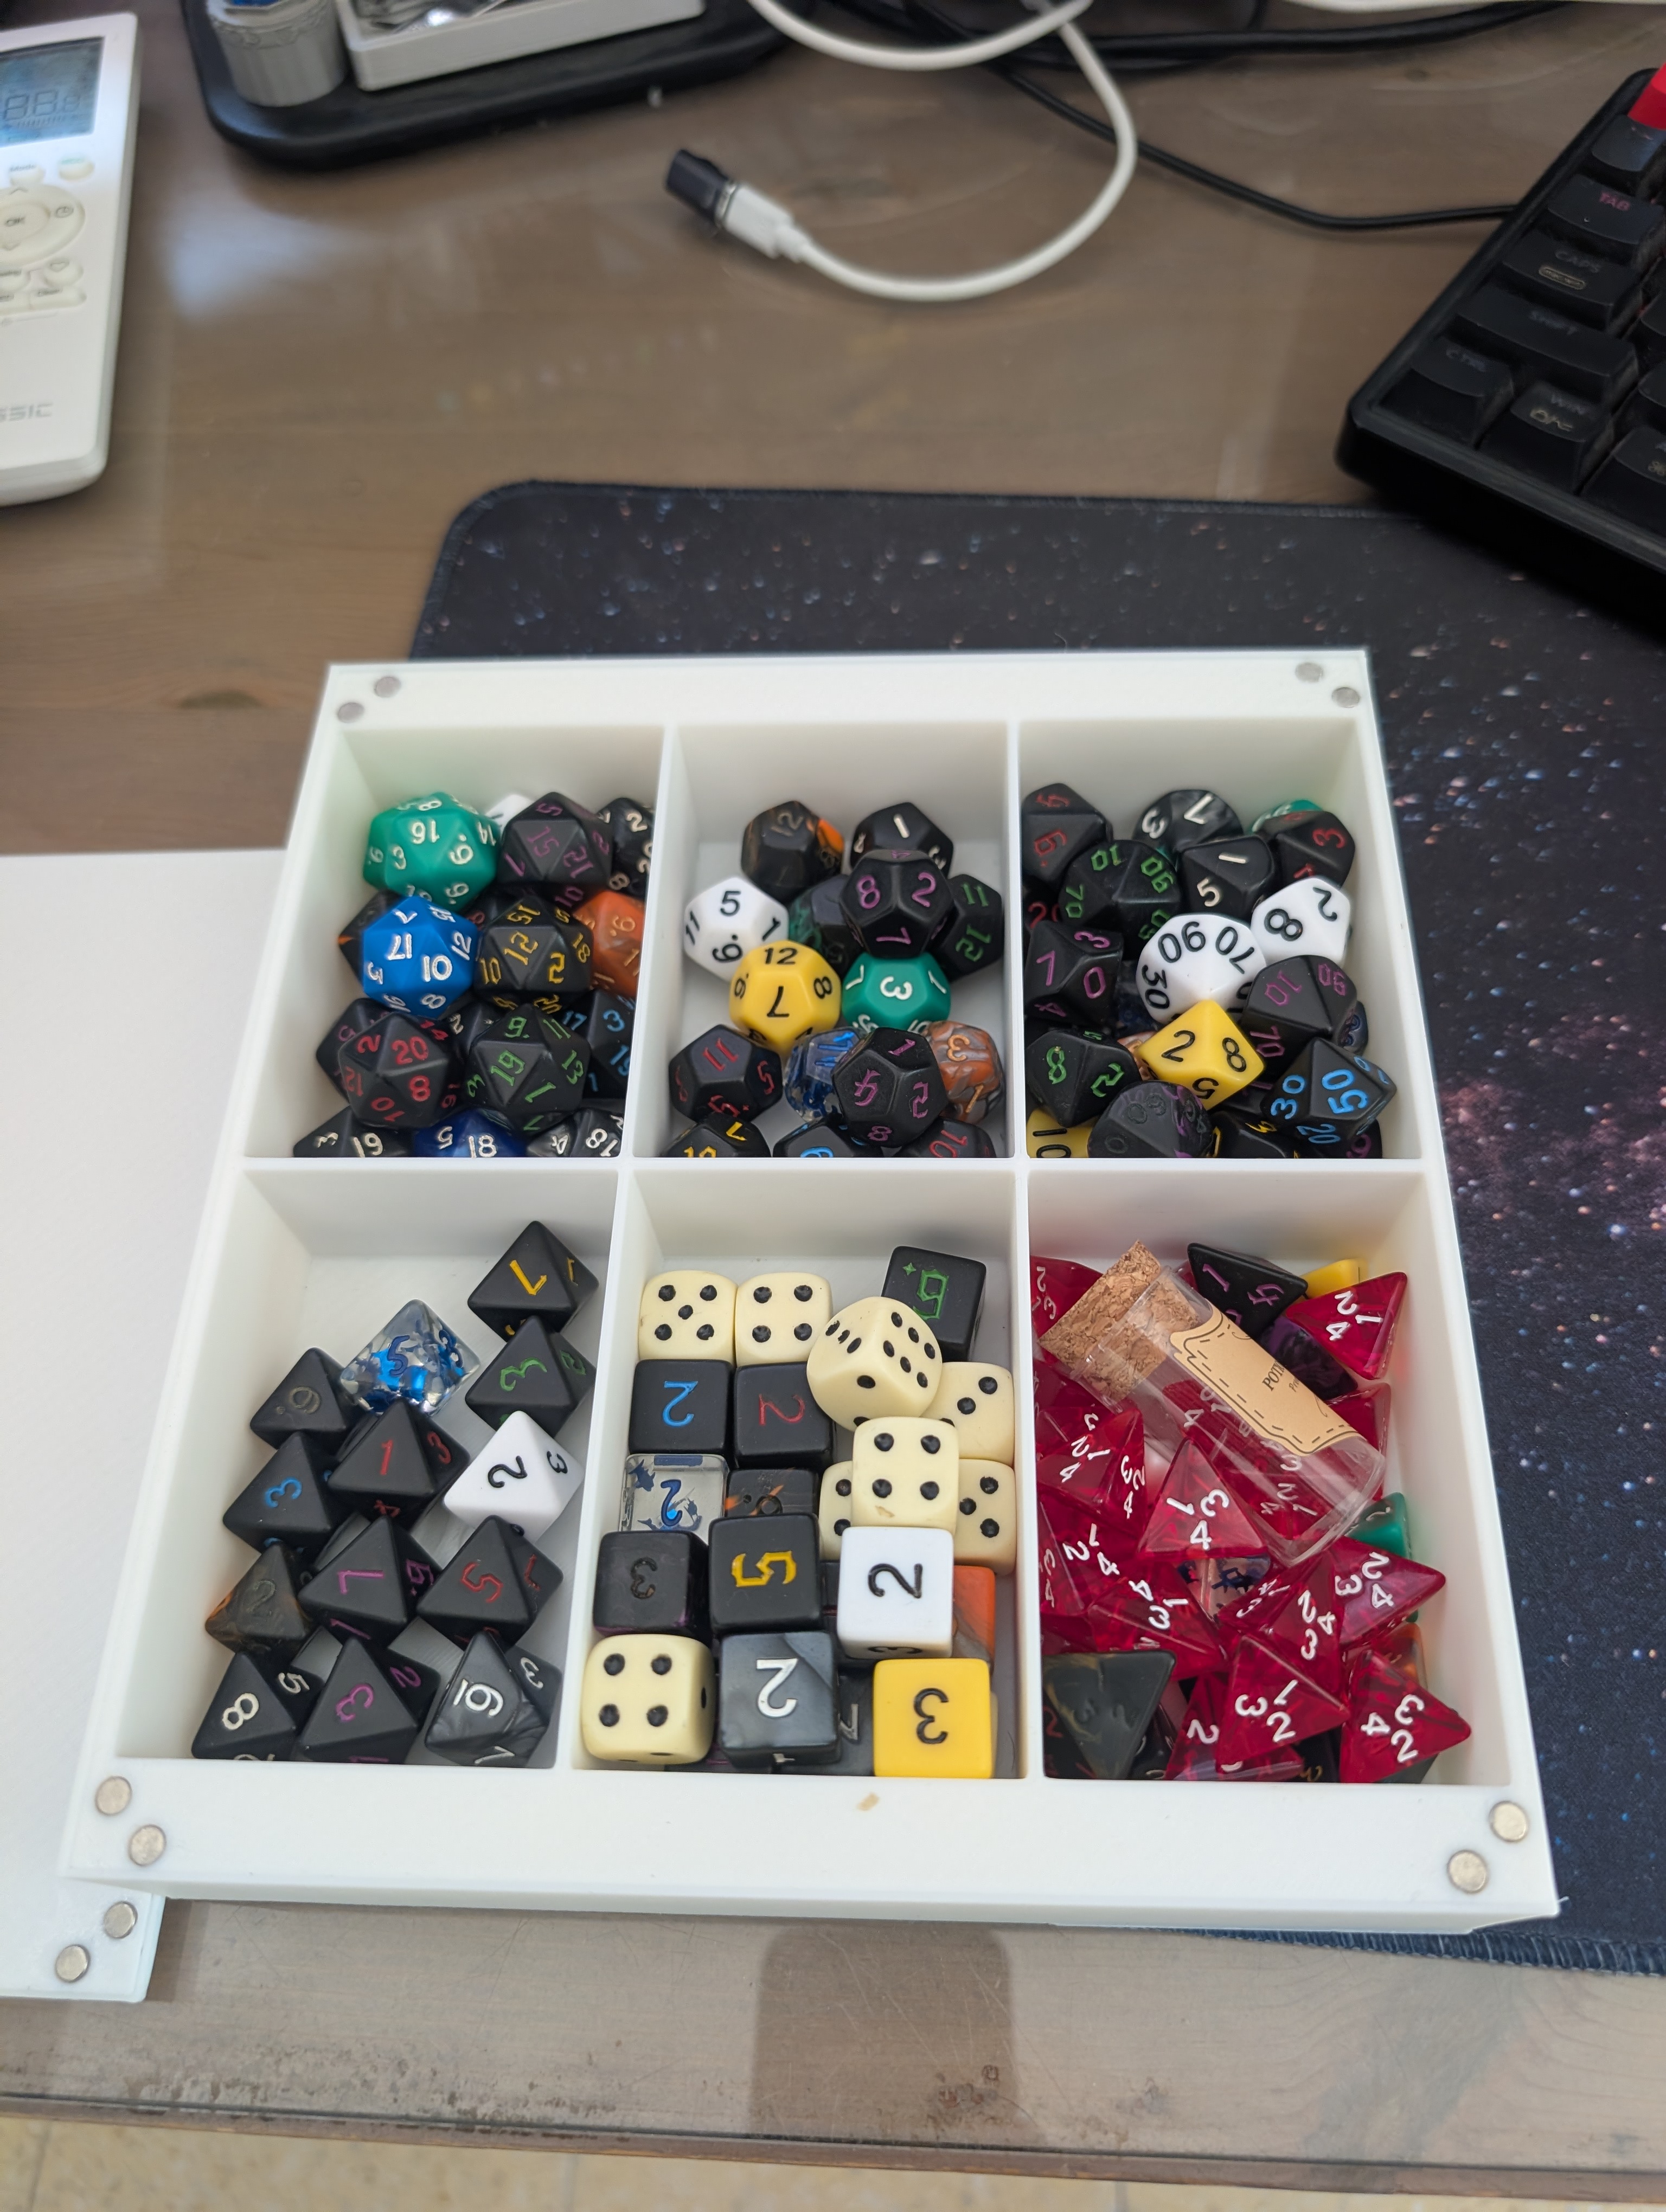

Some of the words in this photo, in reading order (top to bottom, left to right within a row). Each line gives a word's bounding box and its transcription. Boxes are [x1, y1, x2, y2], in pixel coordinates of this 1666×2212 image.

[1142, 809, 1167, 839] 3
[1184, 795, 1213, 825] 7
[893, 814, 911, 839] 1
[1312, 828, 1345, 849] 3
[720, 891, 741, 917] 5
[856, 874, 881, 909] 8
[912, 871, 937, 908] 2
[962, 882, 989, 907] 11
[1196, 876, 1221, 907] 5
[1312, 886, 1337, 922] 2
[685, 911, 700, 946] 11
[1074, 930, 1111, 949] 3
[1264, 908, 1303, 941] 8
[504, 930, 539, 965] 12
[572, 933, 591, 963] 18
[765, 948, 798, 965] 12
[422, 955, 453, 982] 10
[479, 957, 502, 985] 10
[548, 951, 565, 984] 2
[813, 976, 832, 999] 8
[880, 975, 913, 1000] 3
[1083, 967, 1106, 999] 0
[1141, 964, 1170, 1009] 30
[1265, 971, 1302, 1006] 10
[420, 993, 446, 1009] 8
[767, 986, 790, 1017] 7
[603, 1008, 625, 1032] 3
[356, 1034, 381, 1053] 2
[392, 1036, 429, 1065] 20
[702, 1038, 738, 1072] 11
[947, 1034, 970, 1062] 3
[1161, 1030, 1195, 1063] 2
[1222, 1037, 1247, 1072] 8
[491, 1050, 525, 1086] 19
[561, 1050, 584, 1084] 13
[1046, 1046, 1067, 1085] 8
[1090, 1062, 1125, 1098] 2
[409, 1075, 431, 1102] 8
[1271, 1075, 1306, 1120] 30
[1322, 1069, 1368, 1114] 50
[467, 1135, 497, 1158] 18
[868, 1126, 892, 1141] 8
[1202, 1263, 1229, 1293] 1
[1335, 1290, 1359, 1316] 2
[1326, 1321, 1351, 1341] 4
[1355, 1314, 1384, 1326] 1
[499, 1356, 548, 1391] 3
[662, 1380, 699, 1427] 2
[759, 1393, 805, 1426] 2
[381, 1439, 393, 1475] 1
[1071, 1435, 1091, 1457] 2
[1087, 1449, 1111, 1460] 1
[488, 1455, 528, 1488] 2
[547, 1450, 568, 1474] 3
[1060, 1462, 1081, 1483] 4
[1121, 1455, 1133, 1484] 3
[265, 1476, 303, 1508] 3
[660, 1479, 683, 1527] 2
[1167, 1497, 1195, 1515] 1
[1200, 1489, 1229, 1517] 3
[1277, 1483, 1299, 1501] 2
[1089, 1523, 1100, 1547] 1
[1190, 1520, 1212, 1550] 4
[1062, 1541, 1090, 1561] 2
[1097, 1551, 1120, 1576] 4
[1361, 1552, 1389, 1579] 2
[461, 1561, 503, 1603] 5
[630, 1557, 658, 1599] 3
[731, 1550, 797, 1588] 5
[868, 1563, 923, 1599] 2
[1128, 1580, 1154, 1602] 4
[1334, 1574, 1363, 1596] 3
[1372, 1583, 1394, 1609] 4
[1148, 1605, 1171, 1630] 3
[1162, 1598, 1189, 1608] 1
[1298, 1590, 1317, 1623] 2
[1317, 1611, 1336, 1635] 4
[1300, 1629, 1318, 1661] 3
[278, 1672, 311, 1694] 5
[520, 1657, 543, 1689] 3
[756, 1657, 798, 1719] 2
[336, 1683, 374, 1722] 3
[1235, 1694, 1268, 1717] 3
[1273, 1680, 1298, 1705] 1
[222, 1692, 259, 1731] 8
[914, 1688, 950, 1745] 3
[1360, 1712, 1391, 1736] 4
[1395, 1694, 1425, 1726] 3
[1186, 1719, 1220, 1745] 2
[1266, 1711, 1297, 1743] 2
[1391, 1729, 1419, 1763] 2
